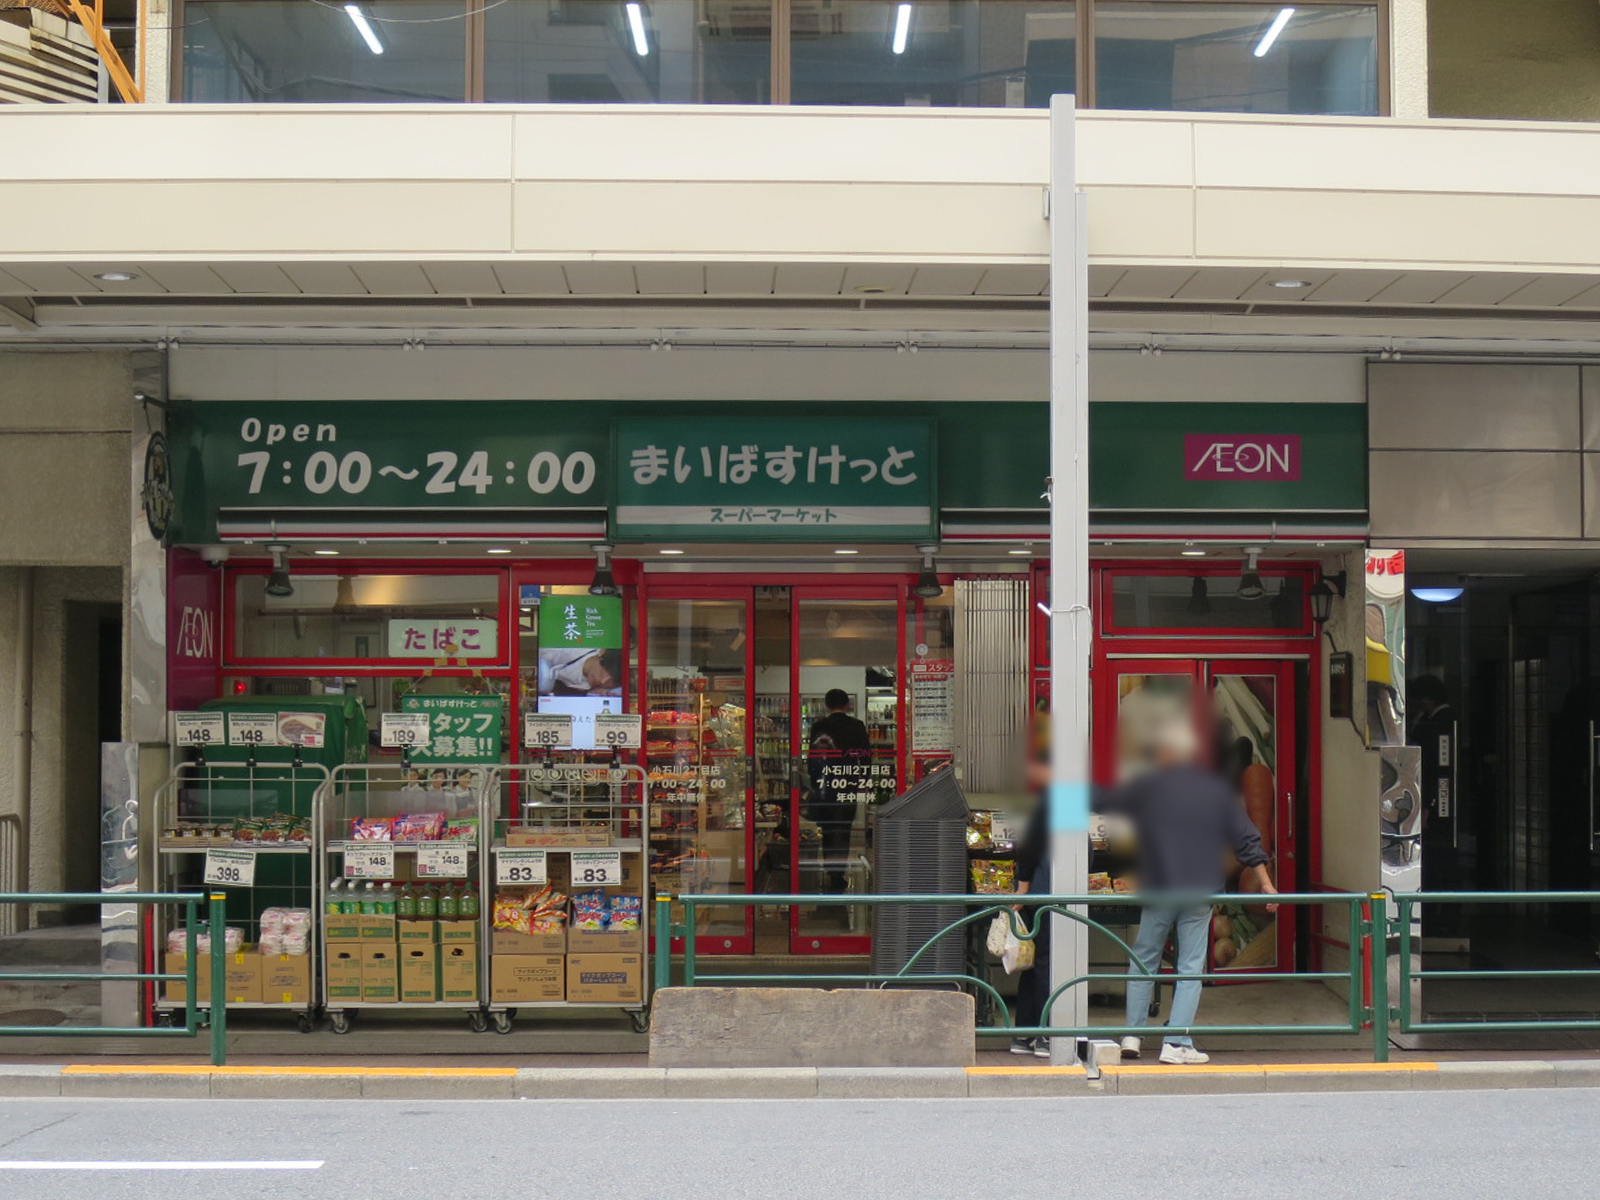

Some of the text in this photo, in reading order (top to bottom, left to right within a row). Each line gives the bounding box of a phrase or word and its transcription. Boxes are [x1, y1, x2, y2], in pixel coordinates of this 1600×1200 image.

[240, 417, 337, 445] Open
[629, 444, 918, 485] まいばすけっと
[710, 507, 838, 523] スーパーマーケット
[563, 603, 582, 641] 生茶
[404, 627, 481, 650] たばこ
[422, 699, 478, 709] まいばすけっと
[429, 712, 493, 733] タッフ
[187, 728, 211, 742] 148
[240, 729, 264, 743] 148
[536, 730, 560, 744] 185
[606, 730, 628, 744] 99
[652, 765, 721, 776] 小石川2丁目店
[821, 765, 891, 776] 小石川2丁目店
[836, 793, 877, 802] 年中無休
[369, 856, 387, 866] 148
[442, 855, 460, 865] 148
[216, 866, 240, 882] 398
[508, 867, 533, 881] 83
[583, 868, 607, 882] 83
